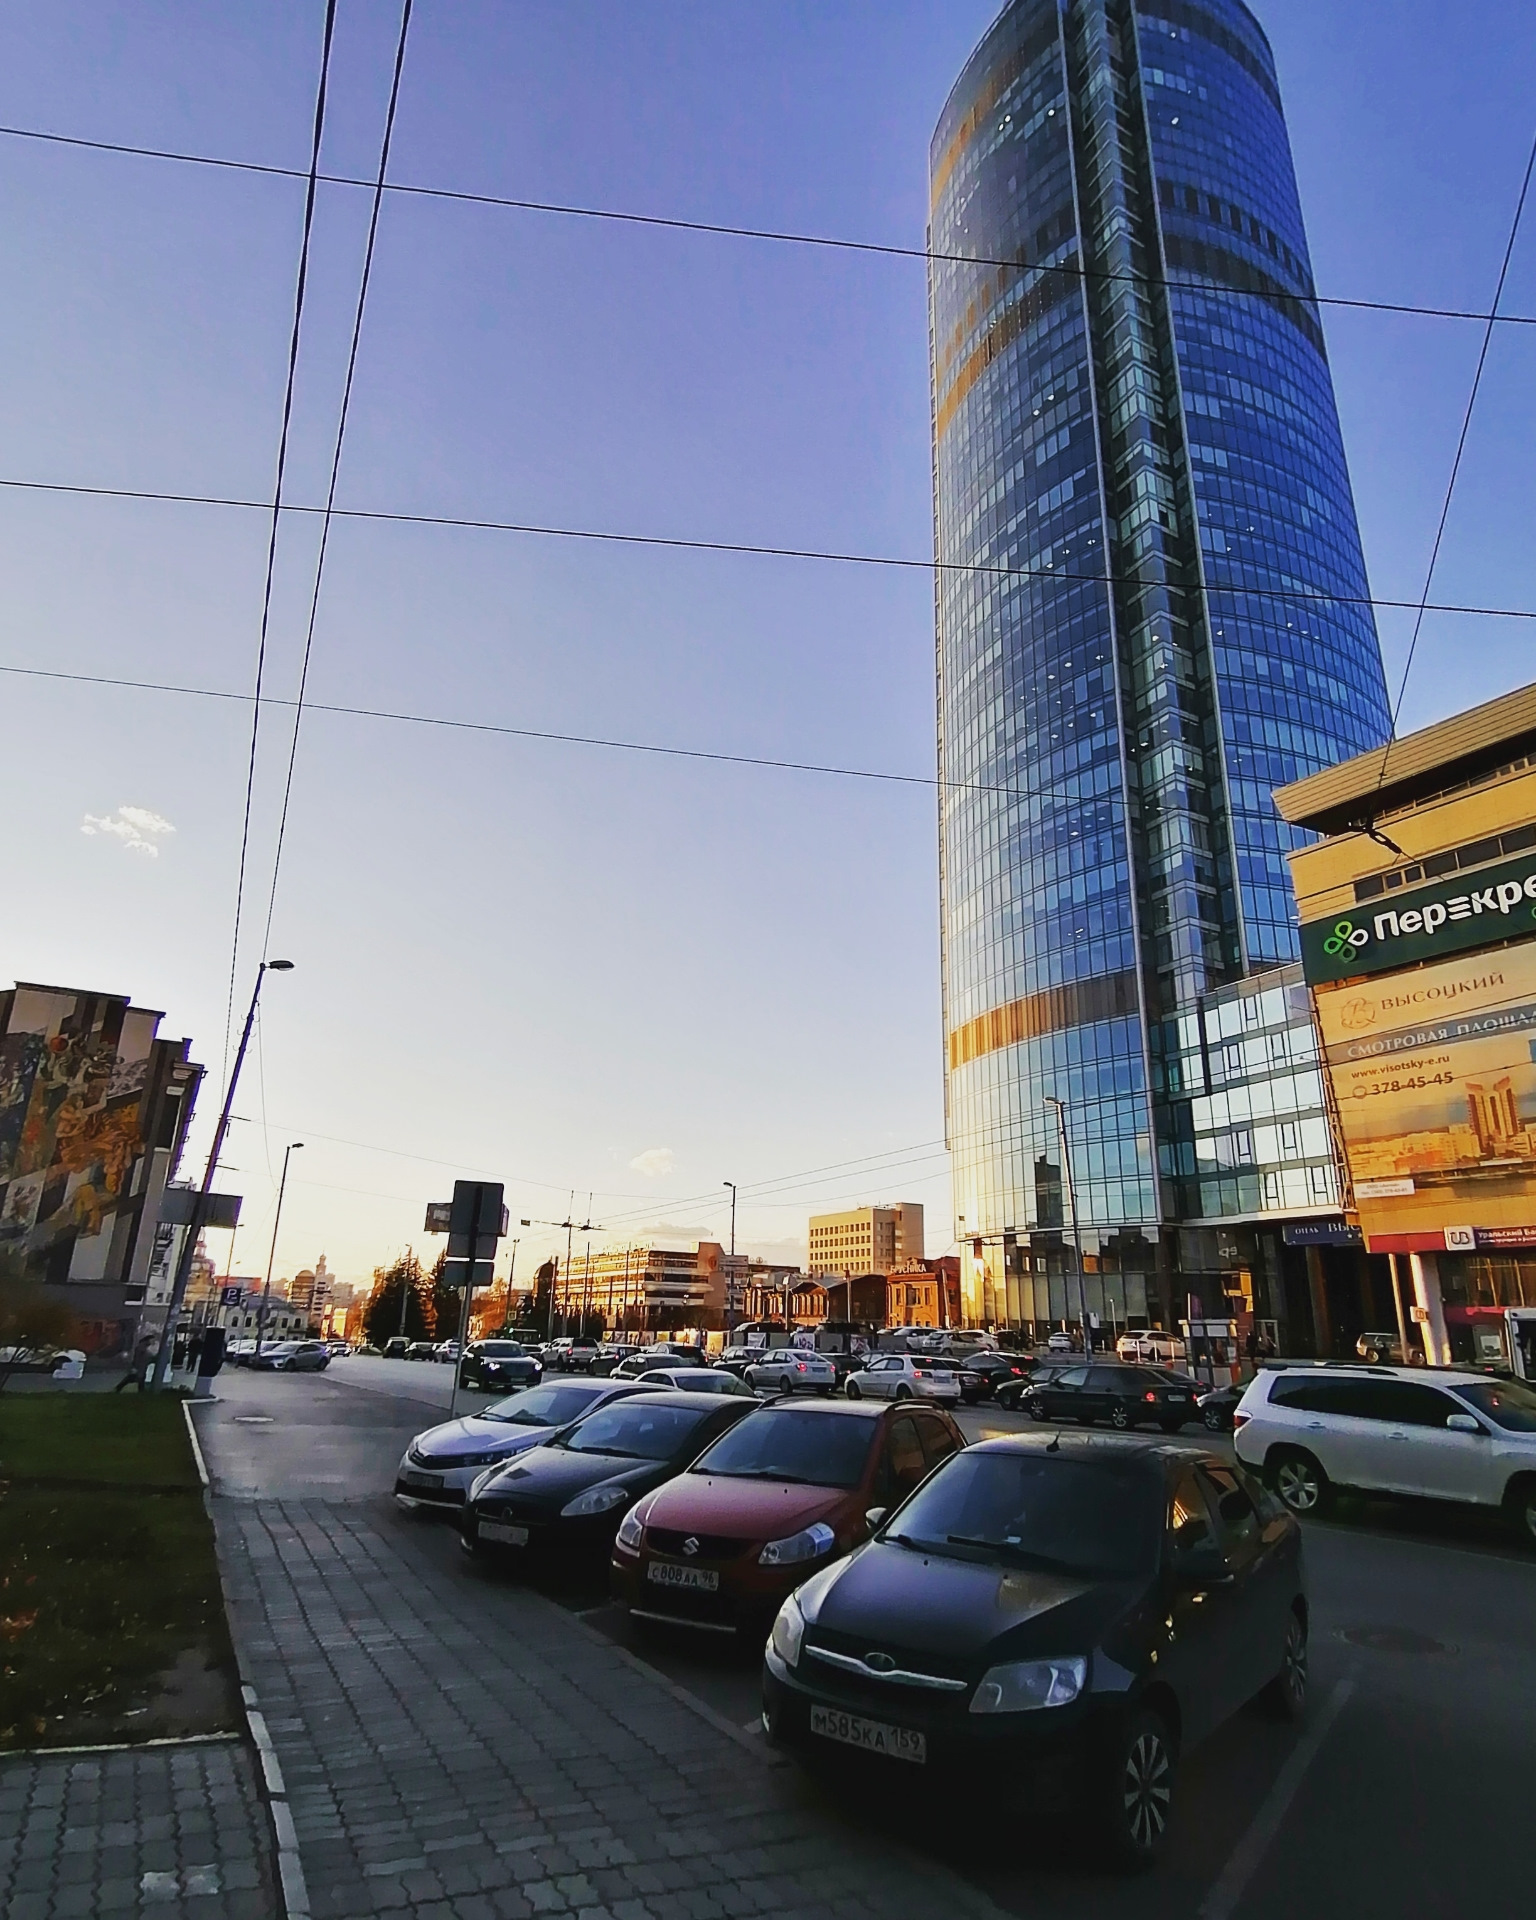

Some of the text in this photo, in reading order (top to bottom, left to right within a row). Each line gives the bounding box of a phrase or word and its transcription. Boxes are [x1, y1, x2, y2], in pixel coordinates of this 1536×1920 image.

[1381, 971, 1505, 1010] ВЫСОЦКИЙ
[1347, 1028, 1448, 1058] СМОТРОВАЯ
[1351, 1056, 1450, 1079] www.visotsky-e.ru
[1371, 1071, 1453, 1095] 378-45-45
